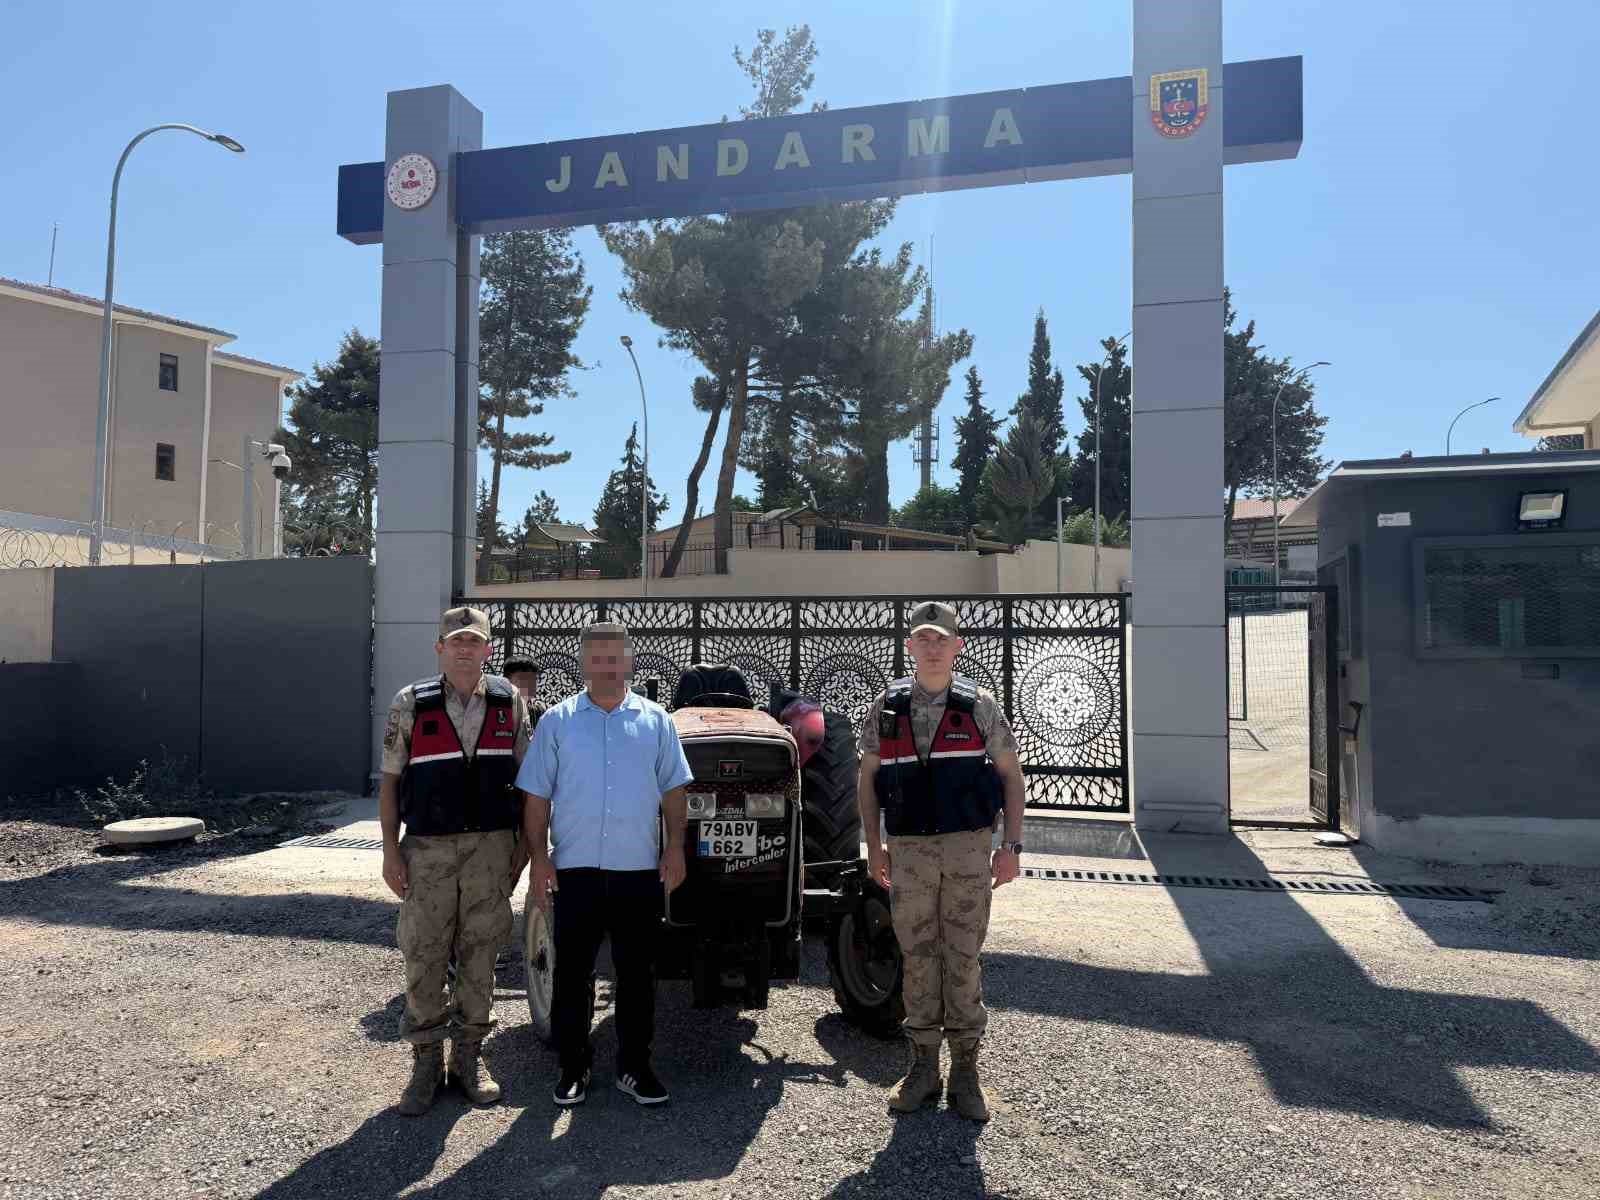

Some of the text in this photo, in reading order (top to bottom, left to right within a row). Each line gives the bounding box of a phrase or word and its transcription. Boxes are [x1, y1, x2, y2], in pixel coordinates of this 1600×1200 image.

[545, 107, 1024, 193] JANDARMA
[703, 822, 755, 837] 79ABV
[713, 840, 744, 855] 662
